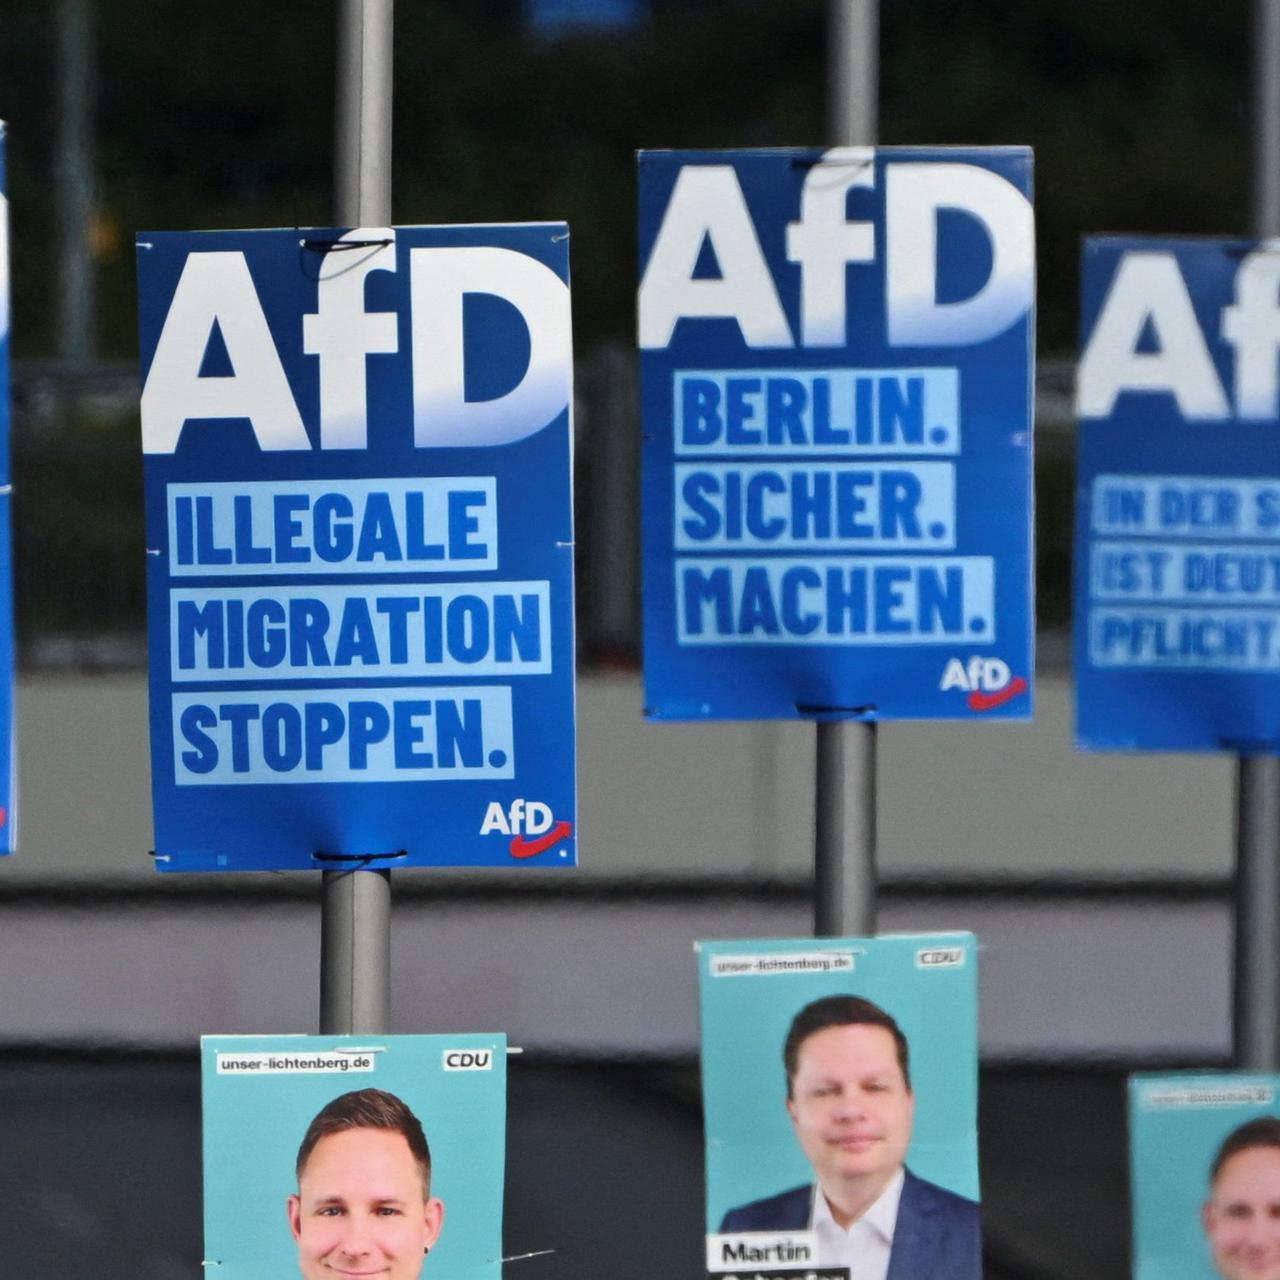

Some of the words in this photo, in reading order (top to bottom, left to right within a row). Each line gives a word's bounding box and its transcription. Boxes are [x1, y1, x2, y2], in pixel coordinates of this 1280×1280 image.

[638, 146, 1035, 350] AfD
[140, 228, 570, 454] AfD
[681, 377, 950, 447] BERLIN.
[175, 489, 489, 566] ILLEGALE
[681, 471, 947, 542] SICHER.
[1104, 486, 1146, 524] IN
[1160, 488, 1244, 527] DER
[683, 564, 987, 637] MACHEN.
[1103, 552, 1173, 593] IST
[177, 593, 541, 670] MIGRATION
[939, 656, 1011, 692] AfD
[181, 699, 507, 774] STOPPEN.
[479, 798, 553, 836] AfD
[221, 1056, 370, 1072] unser-lichtenberg.de
[446, 1053, 489, 1068] CDU
[722, 1241, 811, 1262] Martin
